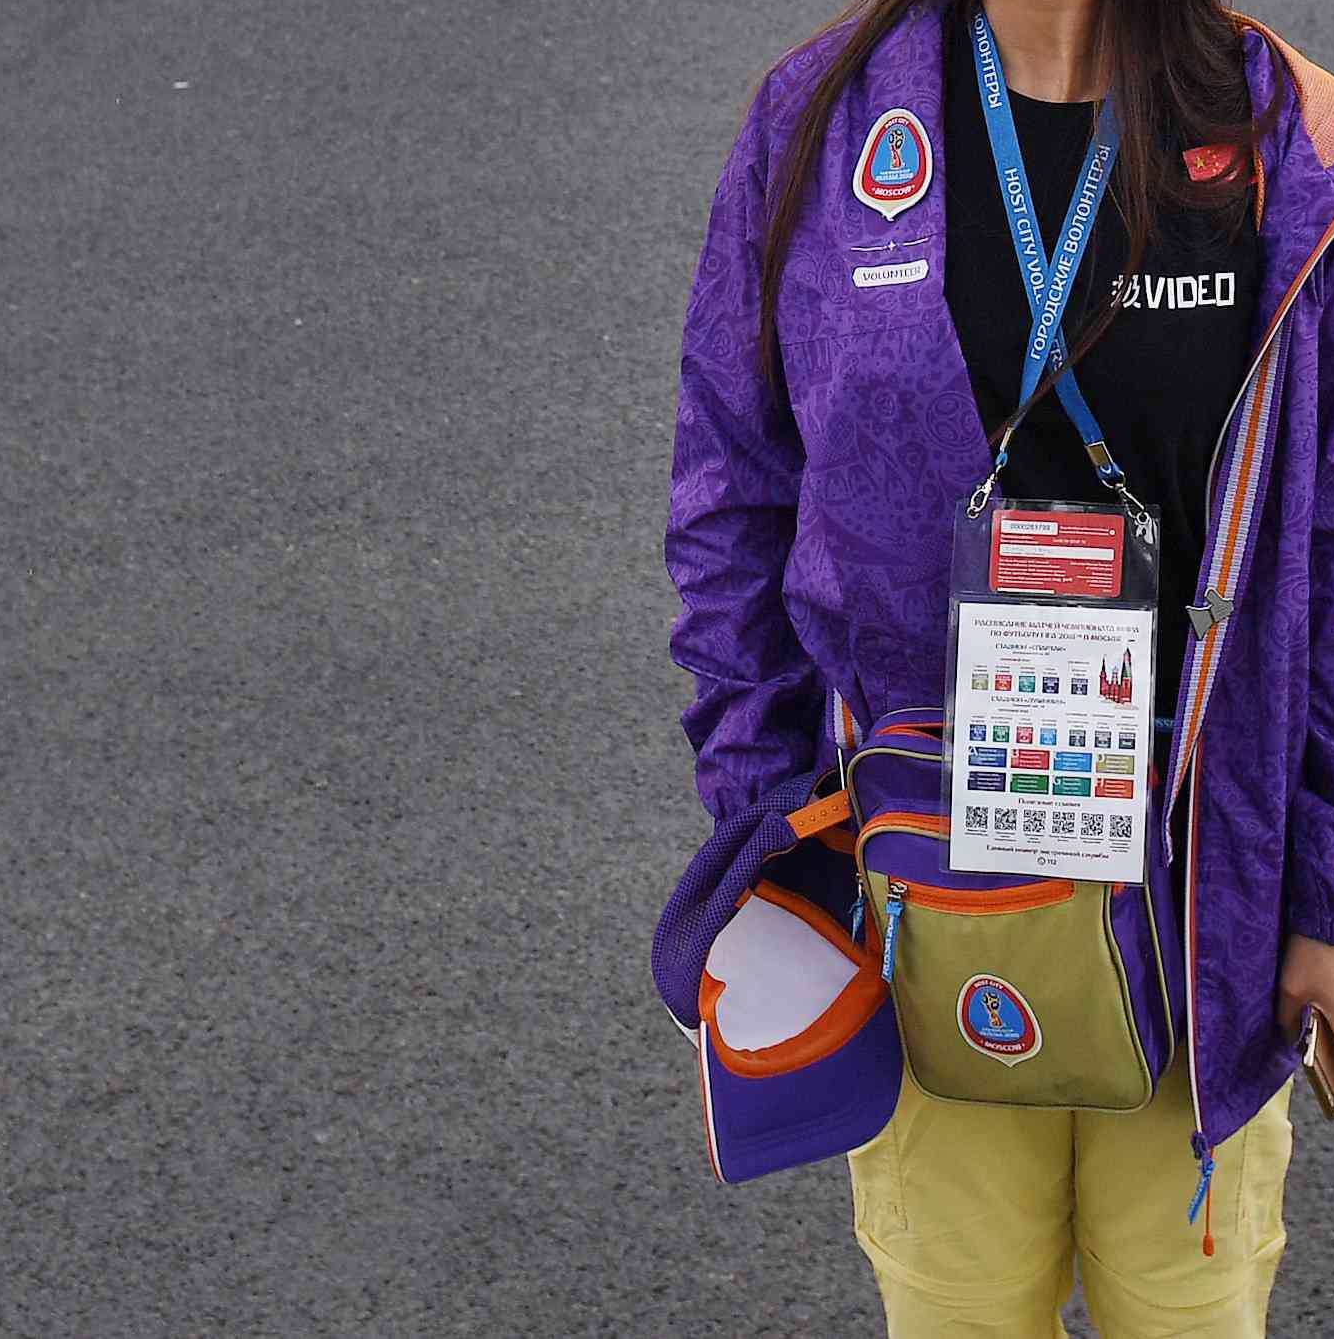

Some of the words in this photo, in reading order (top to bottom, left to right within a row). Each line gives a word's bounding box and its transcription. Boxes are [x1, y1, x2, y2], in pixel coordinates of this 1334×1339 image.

[1004, 167, 1028, 215] HOST
[1017, 218, 1038, 256] CITY
[1030, 254, 1074, 360] ГОРОДСКИЕ
[1063, 144, 1111, 254] ВОЛОНТЕРЫ
